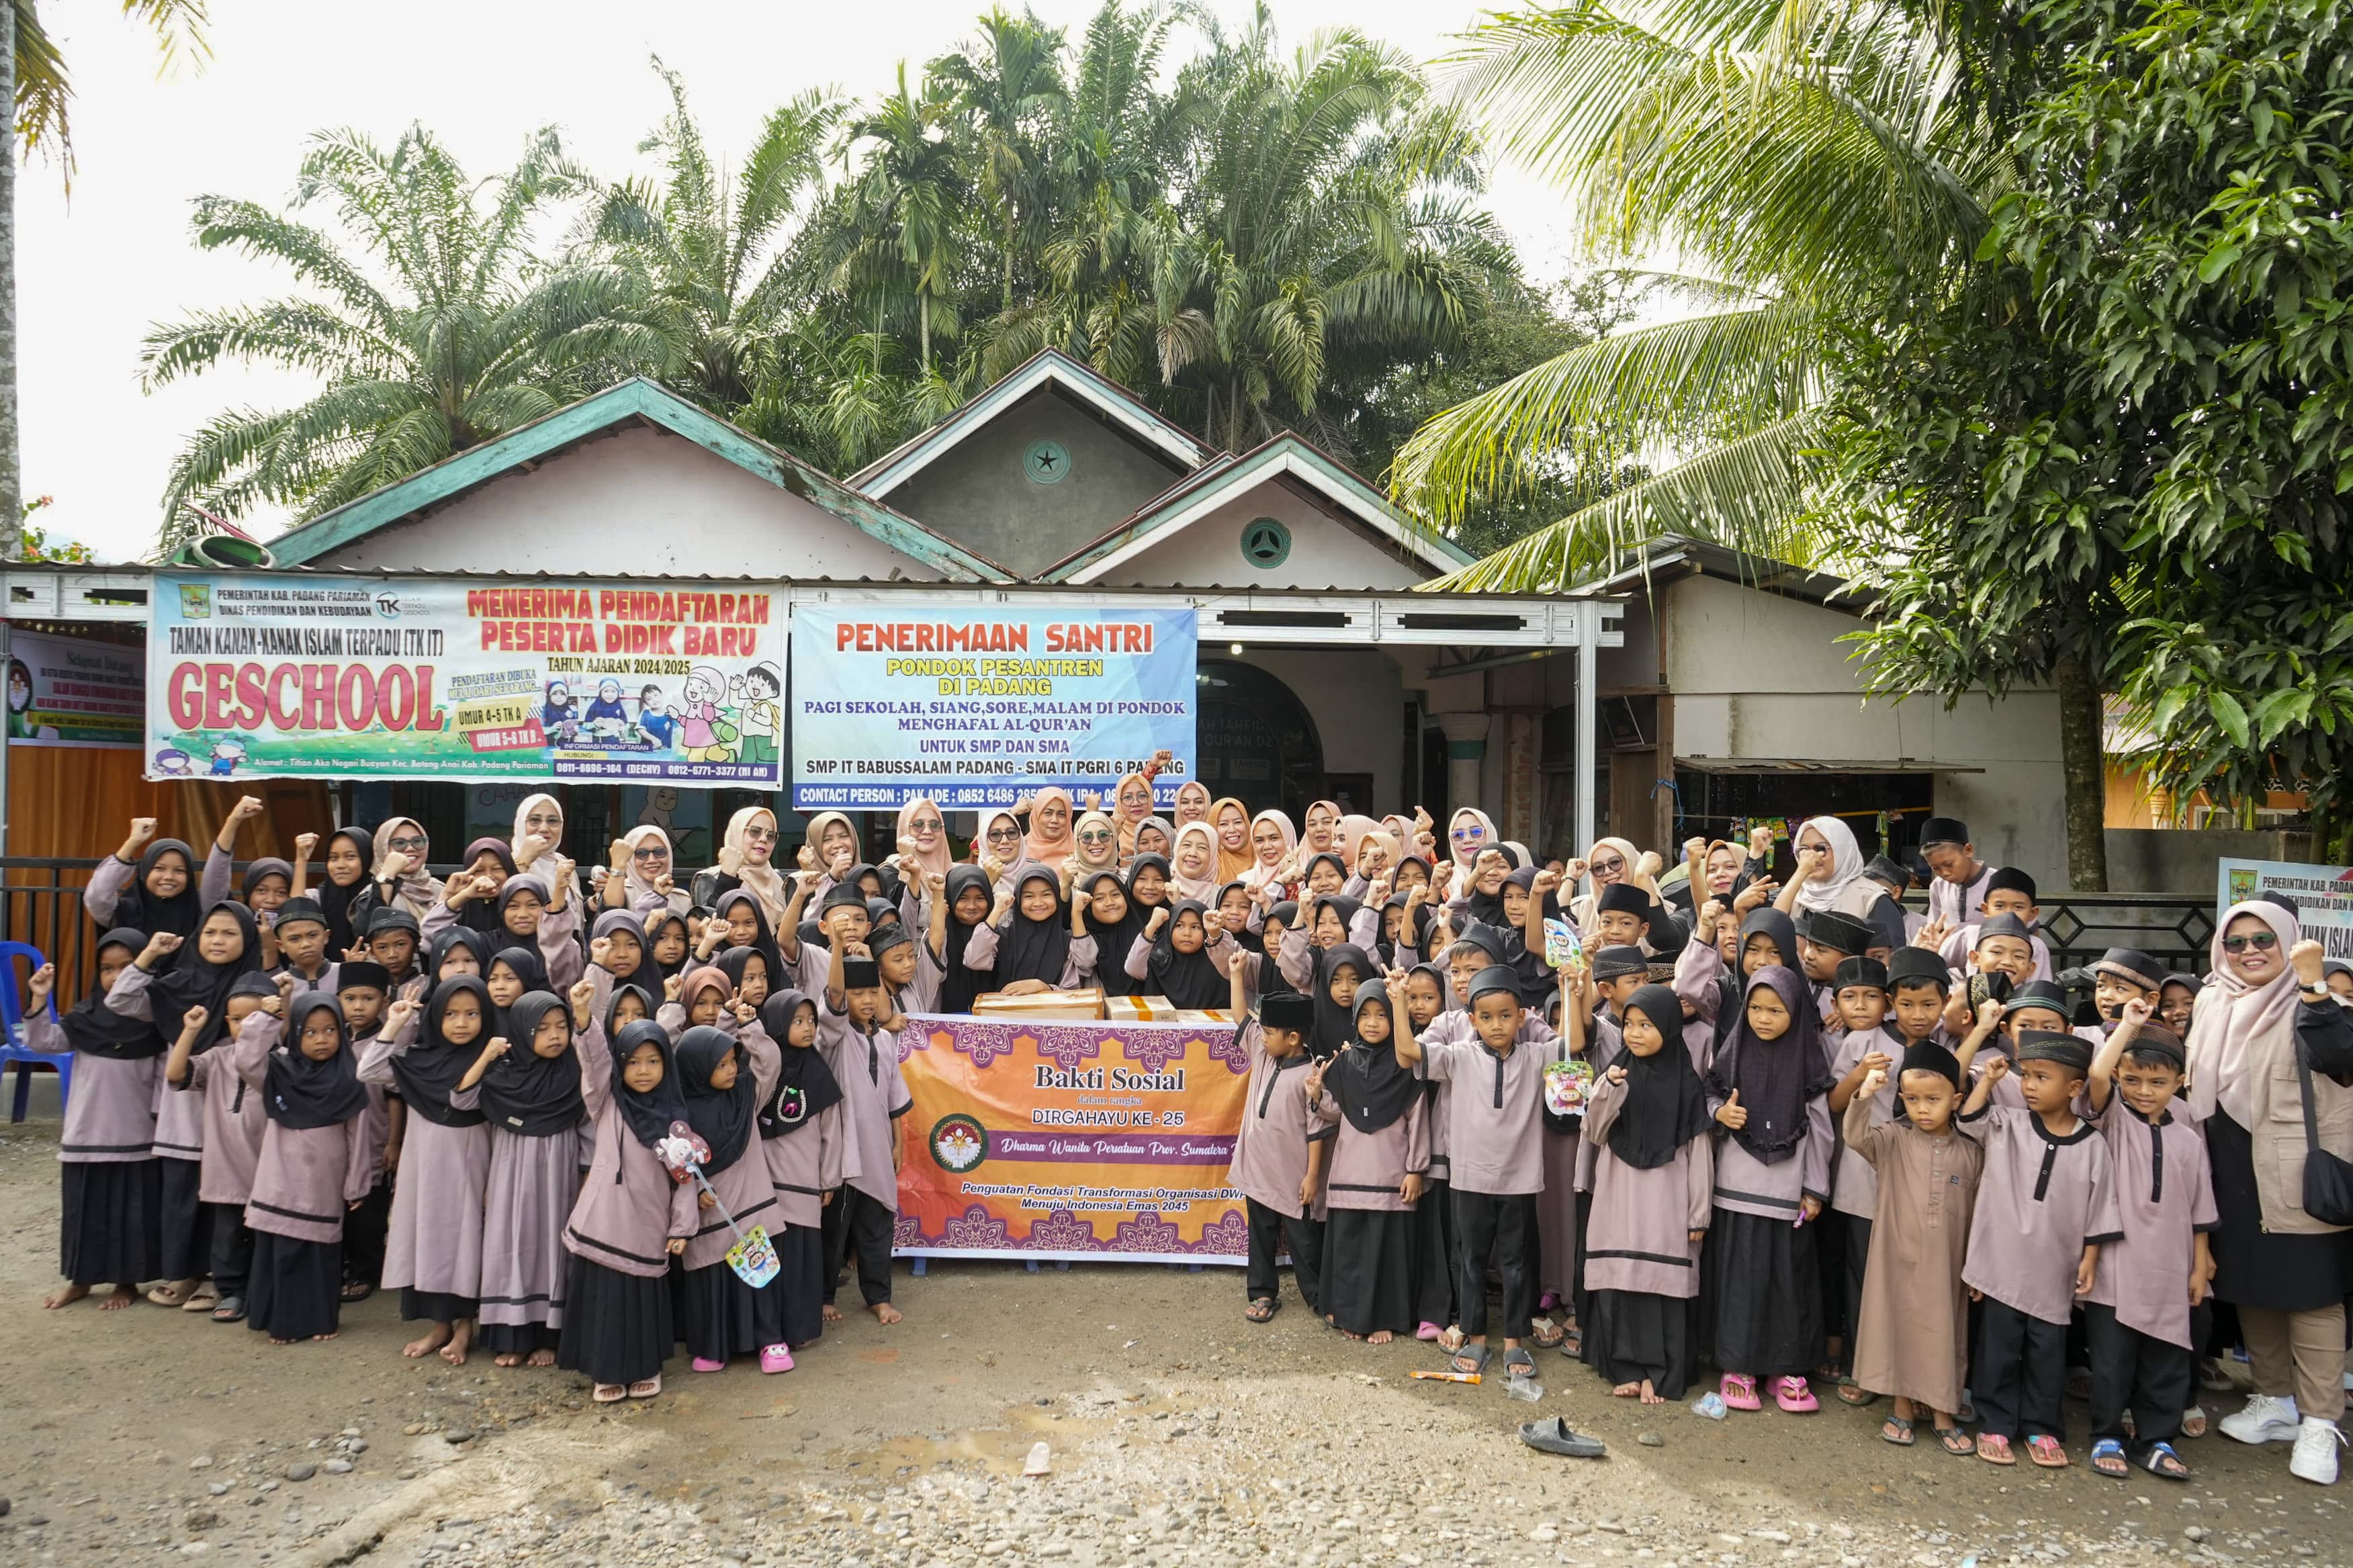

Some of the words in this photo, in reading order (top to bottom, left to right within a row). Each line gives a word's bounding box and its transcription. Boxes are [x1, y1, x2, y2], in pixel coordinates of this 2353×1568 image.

[217, 590, 269, 600] PEMERINTAH
[271, 590, 290, 601] KAB.
[293, 590, 324, 601] PADANG
[328, 591, 371, 602] PARIAMAN
[219, 605, 243, 616] DINAS
[247, 606, 297, 616] PENDIDIKAN
[300, 606, 316, 616] DAN
[318, 606, 371, 616] KEBUDAYAAN
[375, 599, 401, 614] TK
[468, 589, 593, 619] MENERIMA
[601, 591, 769, 624] PENDAFTARAN
[169, 627, 211, 655] TAMAN
[215, 627, 302, 655] KANAK-KANAK
[305, 629, 343, 655] ISLAM
[346, 629, 401, 656] TERPADU
[404, 629, 424, 656] (TK
[427, 629, 443, 656] IT)
[482, 620, 597, 653] PESERTA
[605, 624, 676, 655] DIDIK
[684, 626, 756, 657] BARU
[837, 623, 1028, 652] PENERIMAAN
[1047, 623, 1152, 653] SANTRI
[547, 657, 584, 672] TAHUN
[586, 658, 631, 674] AJARAN
[634, 658, 691, 676] 2024/2025
[887, 659, 976, 676] PONDOK
[981, 659, 1103, 677] PESANTREN
[451, 672, 506, 687] PENDAFTARAN
[507, 669, 537, 682] DIBUKA
[938, 678, 961, 695] DI
[966, 678, 1051, 696] PADANG
[168, 661, 443, 731] GESCHOOL
[459, 709, 484, 725] UMUR
[486, 708, 501, 723] 4-5
[503, 707, 513, 722] TK
[516, 706, 521, 721] A
[805, 702, 841, 713] PAGI
[846, 702, 926, 715] SEKOLAH,
[930, 702, 1092, 716] SIANG,SORE,MALAM
[1097, 702, 1113, 714] DI
[1118, 702, 1185, 714] PONDOK
[898, 719, 999, 731] MENGHAFAL
[1004, 718, 1092, 733] AL-QUR'AN
[476, 732, 501, 748] UMUR
[502, 731, 517, 745] 5-6
[519, 729, 529, 744] TK
[920, 739, 966, 753] UNTUK
[970, 739, 1002, 753] SMP
[1006, 740, 1034, 753] DAN
[1038, 739, 1069, 753] SMA
[255, 758, 283, 766] Alamat
[411, 759, 439, 770] Batang
[441, 760, 459, 768] Anai
[462, 759, 479, 768] Kab.
[482, 760, 510, 770] Padang
[512, 761, 548, 769] Pariaman
[668, 765, 736, 776] 0812-6771-3377
[806, 760, 837, 774] SMP
[841, 761, 853, 774] IT
[857, 760, 952, 774] BABUSSALAM
[957, 760, 1013, 774] PADANG
[1026, 761, 1057, 774] SMA
[1061, 761, 1073, 774] IT
[1077, 761, 1110, 774] PGRI
[1114, 761, 1123, 774] 6
[1127, 761, 1184, 774] PANG
[800, 788, 848, 802] CONTACT
[850, 788, 895, 802] PERSON
[903, 788, 924, 802] PAK
[928, 788, 949, 802] ADE
[958, 788, 984, 802] 0852
[987, 788, 1013, 803] 6486
[2263, 876, 2309, 890] PEMERINTAH
[2310, 880, 2327, 892] KAB.
[2332, 898, 2348, 911] DAN
[2299, 923, 2327, 957] ANAK
[1035, 1066, 1103, 1089] Bakti
[1112, 1068, 1185, 1091] Sosial
[1077, 1095, 1107, 1105] dalam
[1109, 1095, 1142, 1106] rangka
[1032, 1110, 1127, 1125] DIRGAHAYU
[1132, 1112, 1151, 1125] KE
[1163, 1112, 1184, 1126] 25
[1001, 1138, 1045, 1153] Dharma
[1048, 1140, 1091, 1155] Wanita
[1149, 1142, 1178, 1156] Prov.
[1181, 1142, 1229, 1156] Sumatera
[962, 1183, 1024, 1196] Penguatan
[1027, 1185, 1074, 1197] Fondasi
[1077, 1187, 1153, 1198] Transformasi
[1156, 1189, 1218, 1201] Organisasi
[1022, 1199, 1065, 1210] Menuju
[1067, 1200, 1122, 1211] Indonesia
[1126, 1201, 1158, 1211] Emas
[1161, 1202, 1188, 1211] 2045
